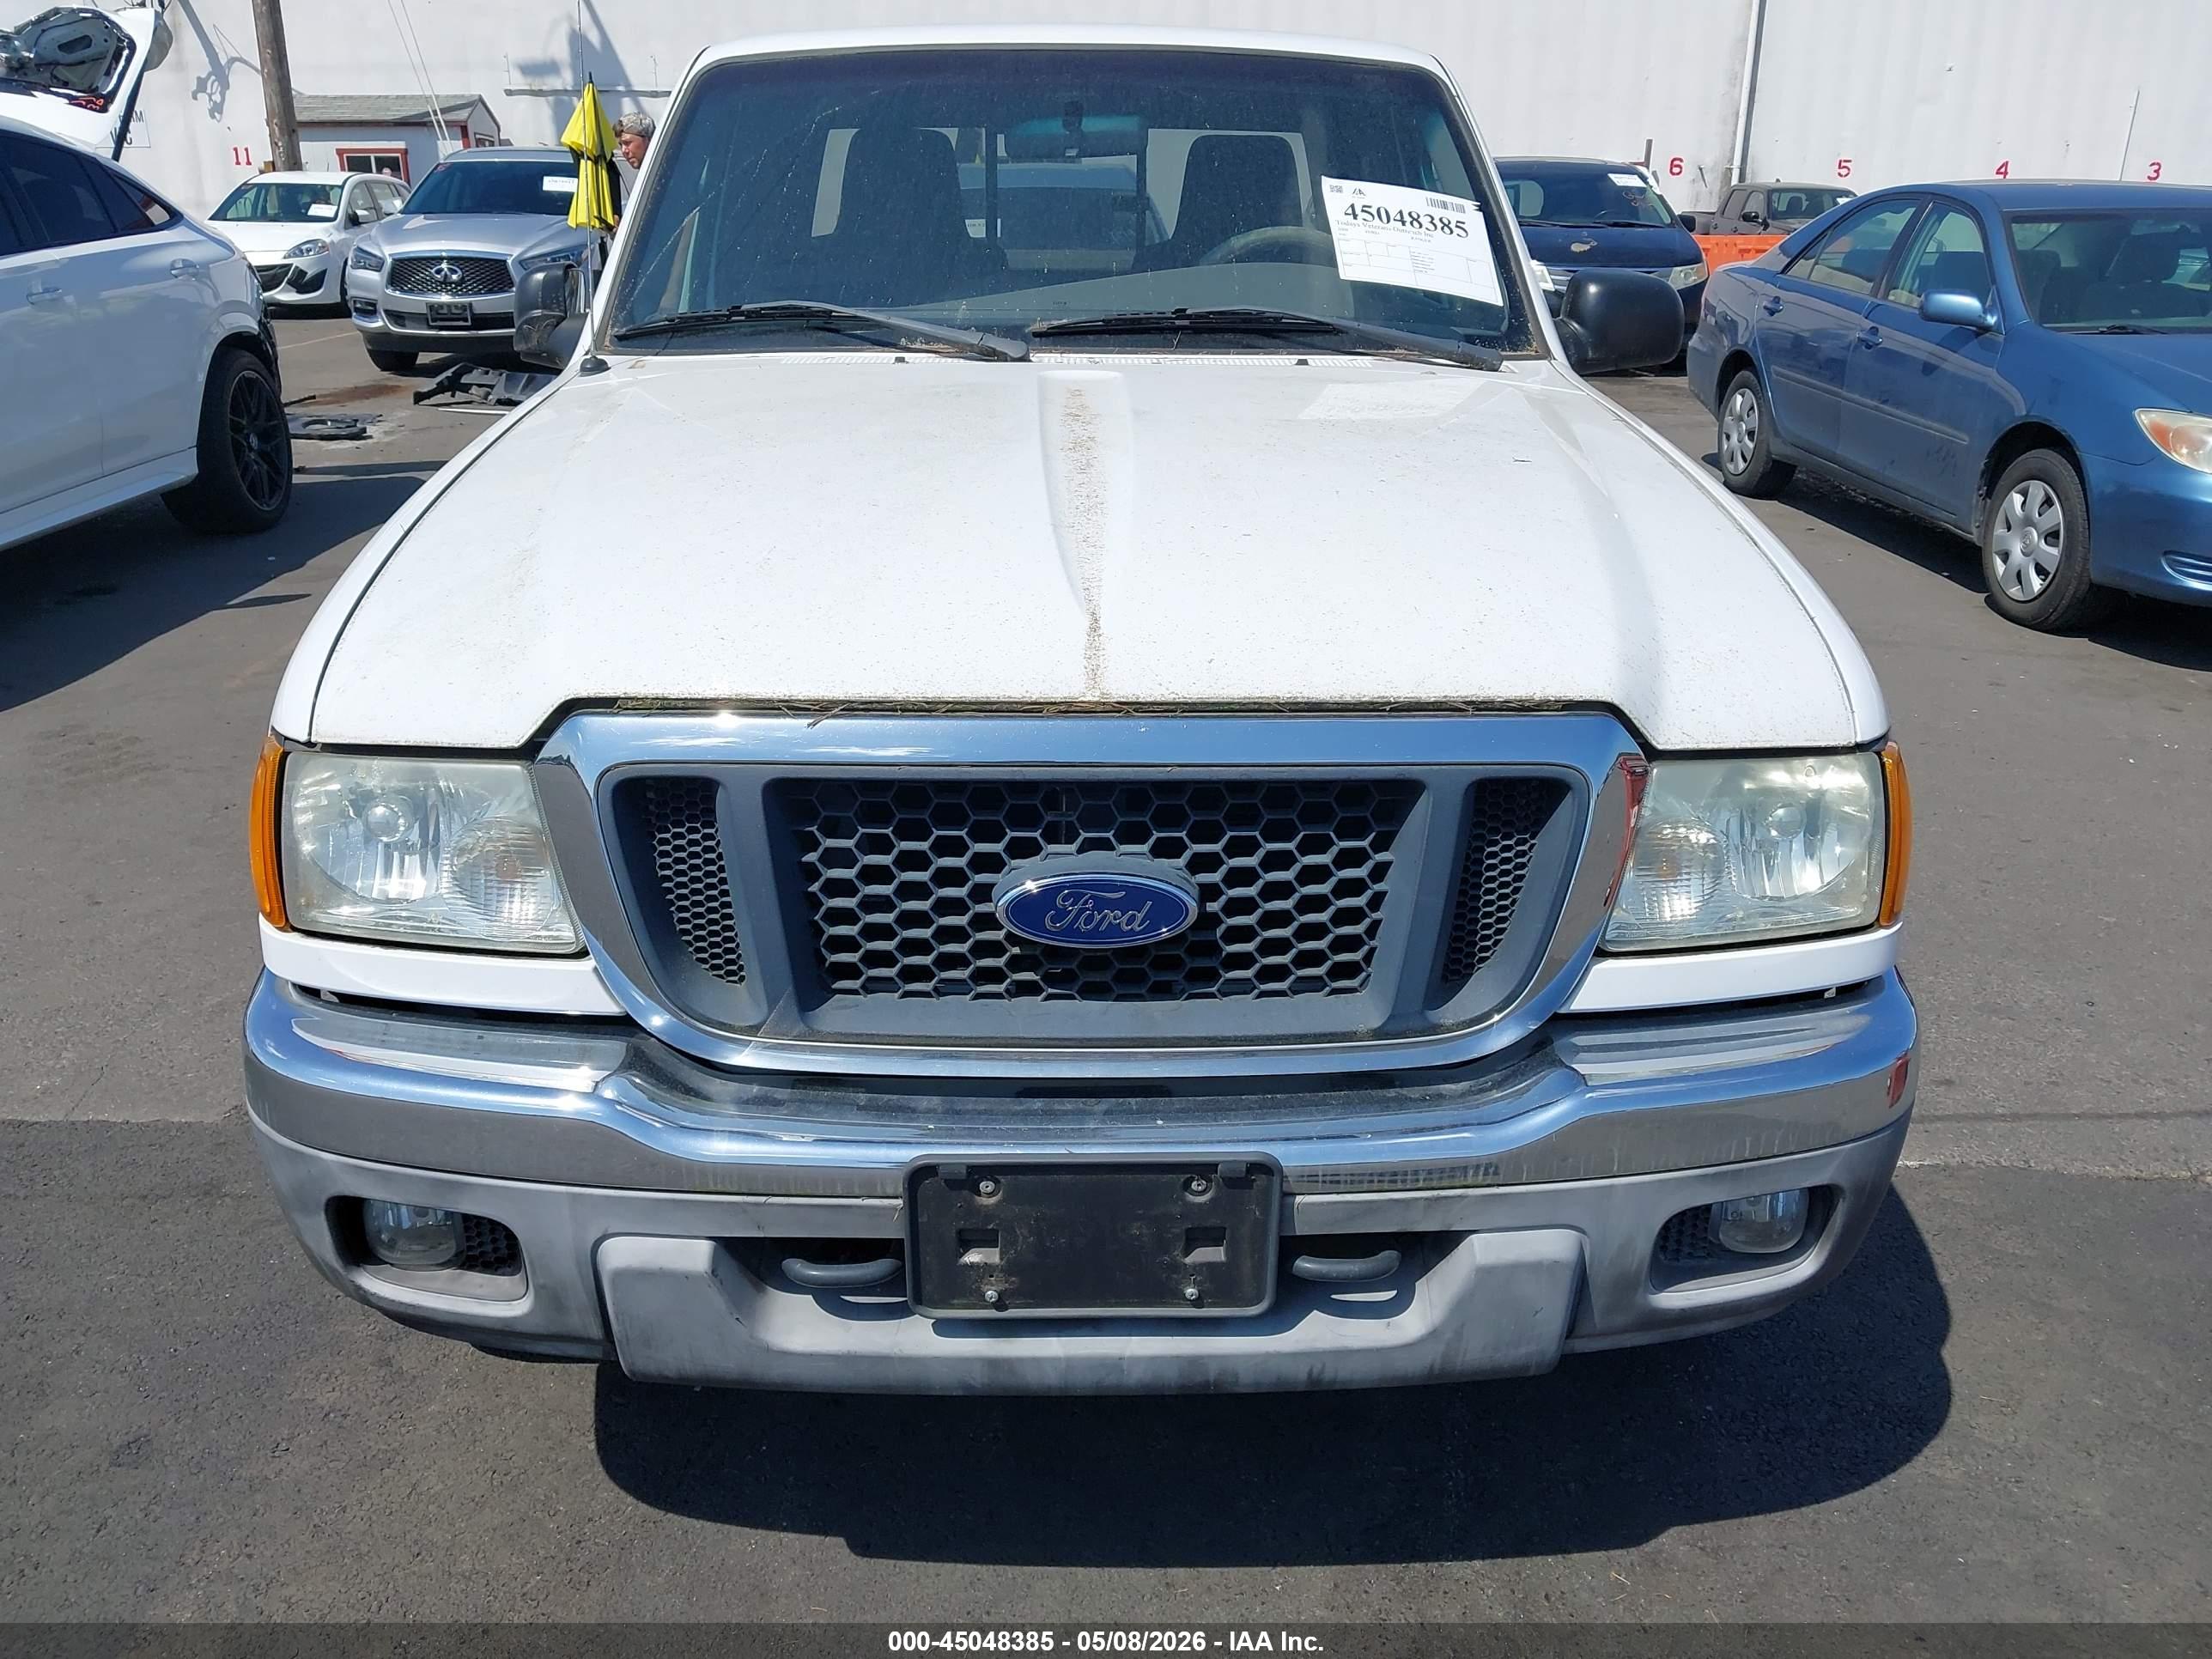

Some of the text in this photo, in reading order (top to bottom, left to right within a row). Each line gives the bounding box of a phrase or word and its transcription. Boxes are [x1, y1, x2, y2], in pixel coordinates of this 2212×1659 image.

[233, 146, 252, 166] 11
[1668, 157, 1685, 176] 6
[1837, 159, 1852, 178] 5
[1995, 160, 2010, 179] 4
[2147, 161, 2162, 181] 3
[1344, 203, 1469, 239] 45048385
[1044, 890, 1152, 933] Ford
